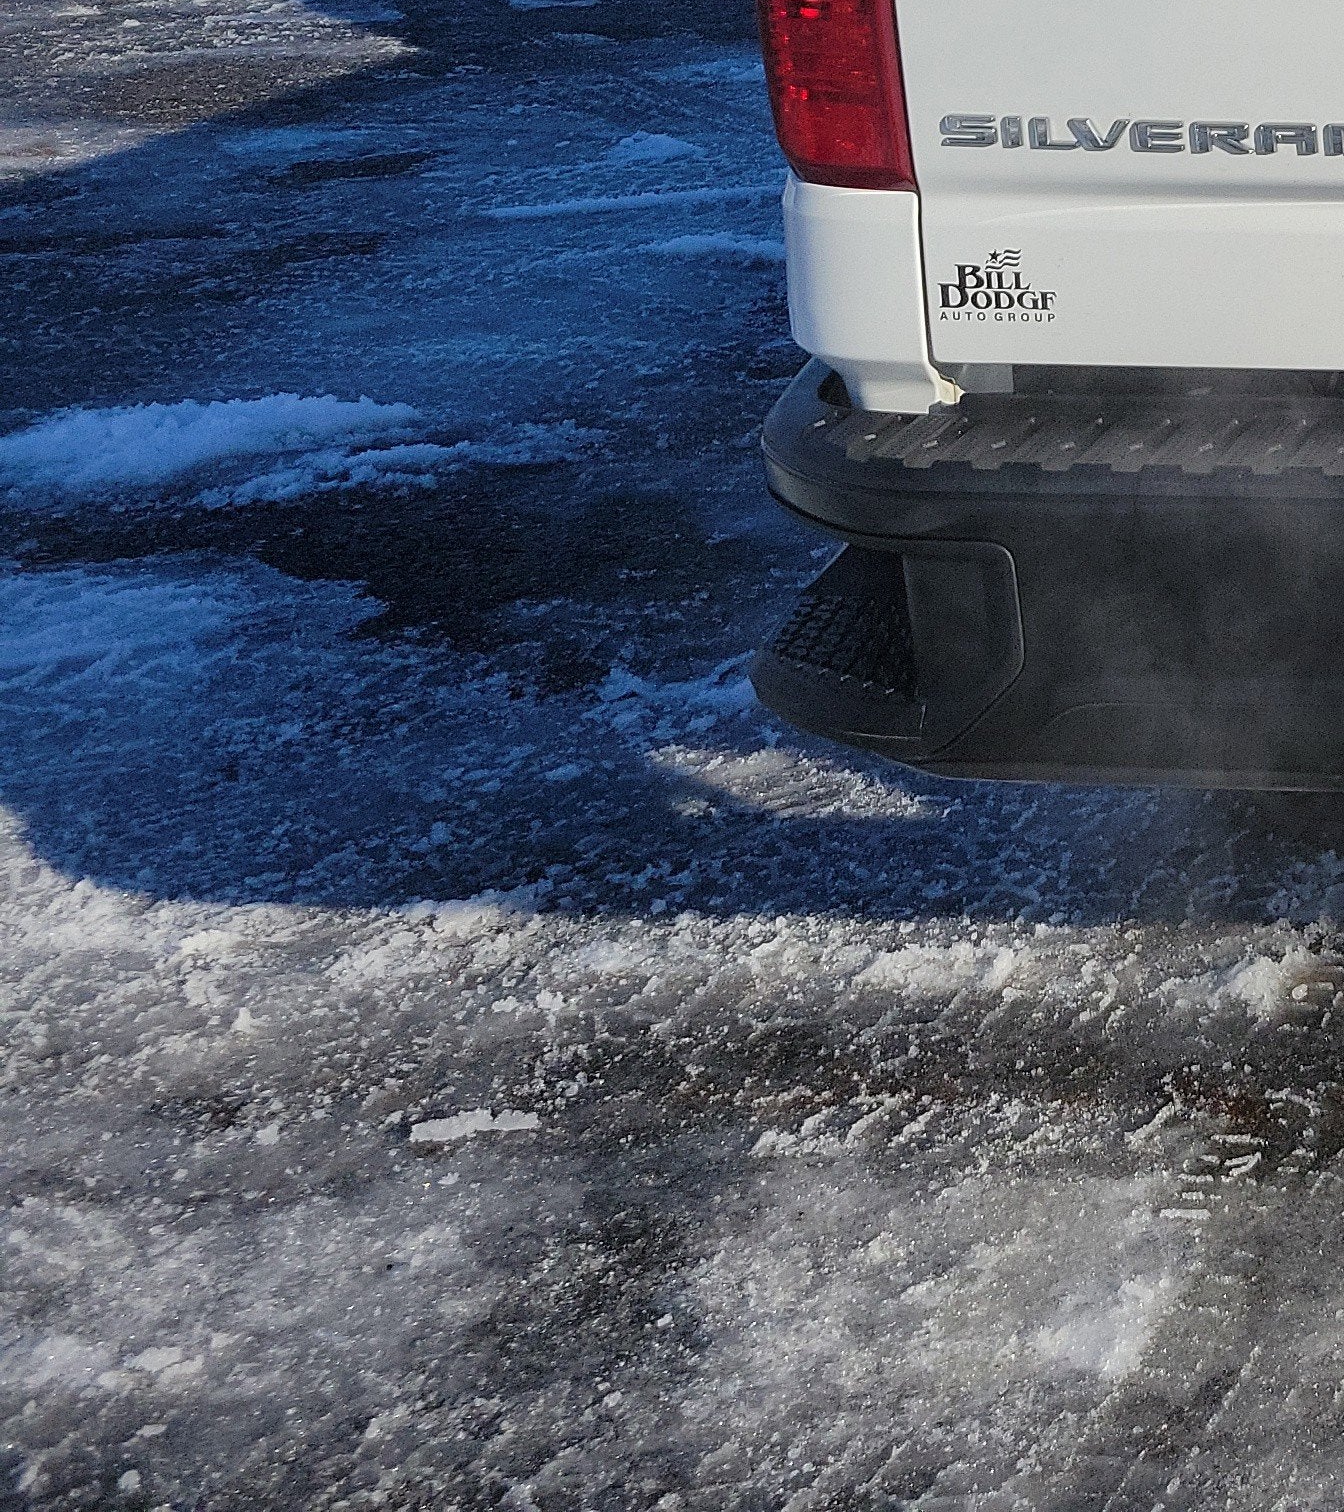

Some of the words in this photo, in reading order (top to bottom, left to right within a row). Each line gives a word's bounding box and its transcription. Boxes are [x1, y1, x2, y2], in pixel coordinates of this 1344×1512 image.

[954, 263, 1031, 290] BILL
[940, 311, 986, 321] AUTO
[994, 312, 1056, 323] GROUP
